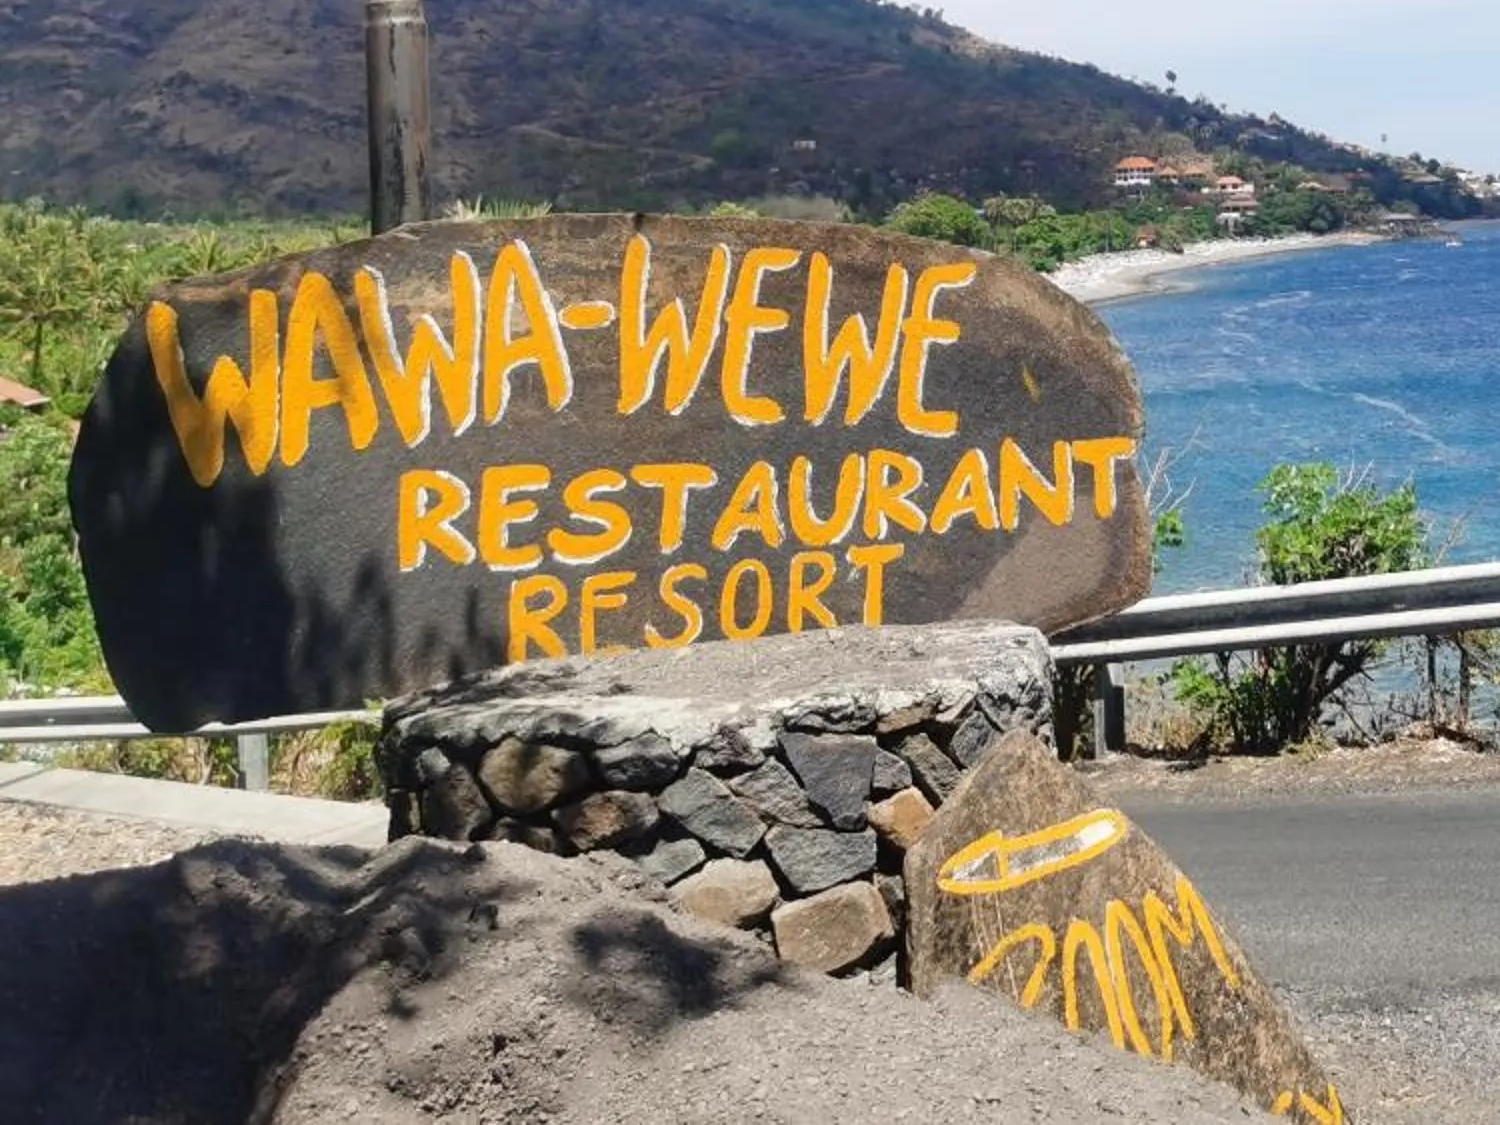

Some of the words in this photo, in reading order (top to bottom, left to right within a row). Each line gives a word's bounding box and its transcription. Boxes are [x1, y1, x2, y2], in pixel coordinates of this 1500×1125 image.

[145, 233, 977, 488] WAWA-WEWE
[398, 436, 1138, 572] RESTAURANT
[507, 543, 905, 664] RESORT
